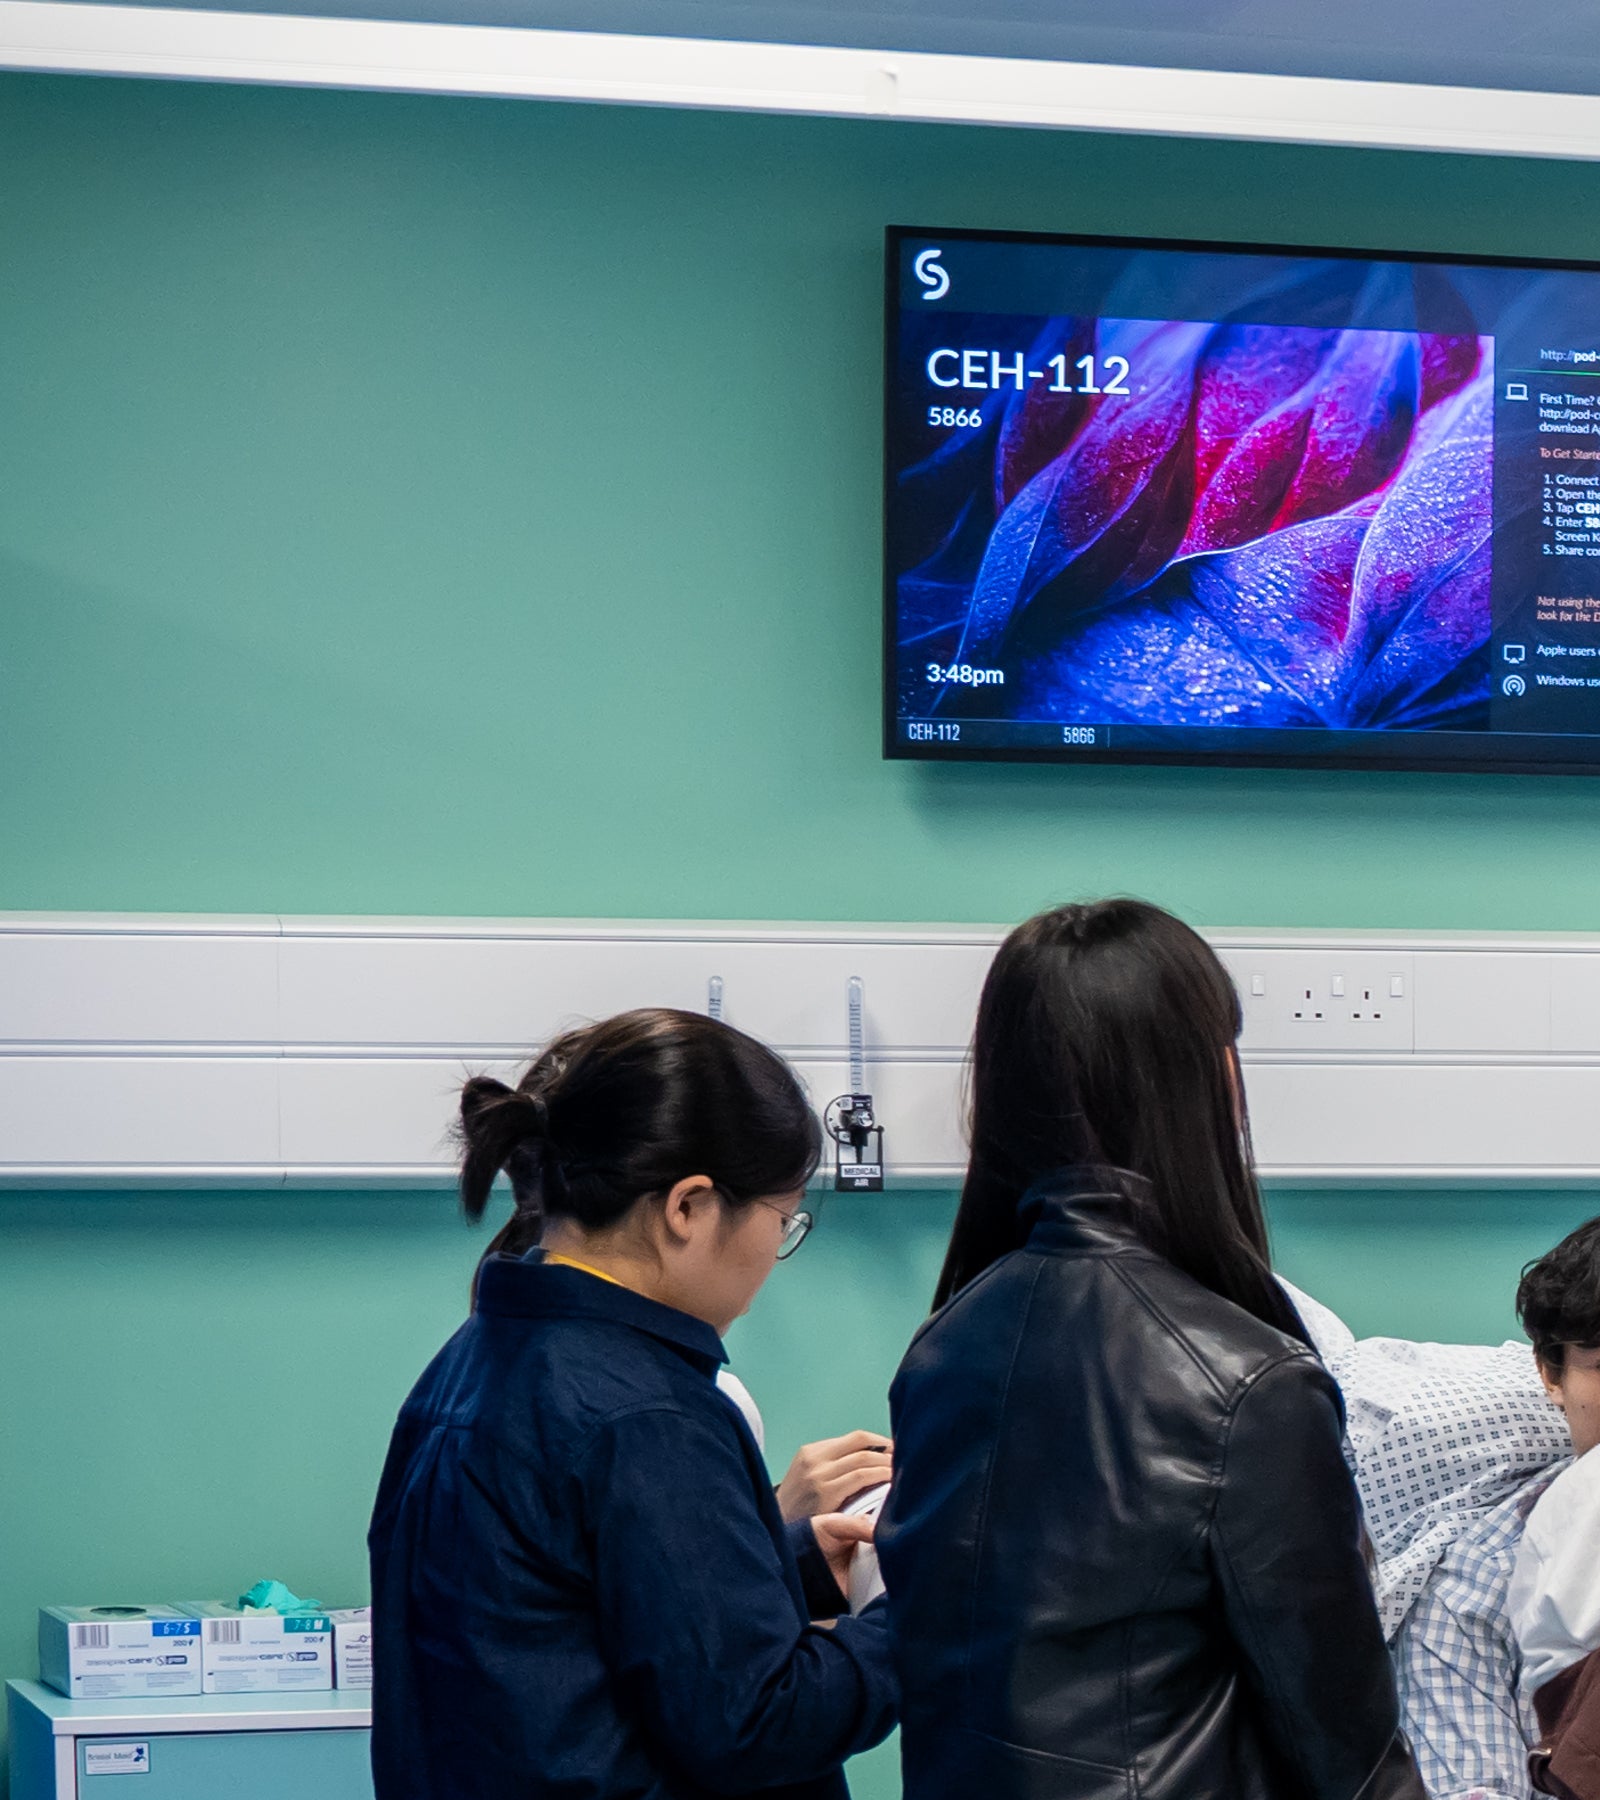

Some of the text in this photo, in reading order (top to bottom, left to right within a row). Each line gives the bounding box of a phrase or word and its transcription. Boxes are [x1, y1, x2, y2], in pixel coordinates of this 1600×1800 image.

[927, 349, 1130, 395] CEH-112
[1540, 393, 1563, 405] First
[1565, 395, 1594, 406] Time?
[928, 406, 982, 428] 5866
[1539, 422, 1589, 435] download
[1540, 448, 1551, 459] To
[1553, 448, 1570, 460] Get
[1544, 475, 1553, 485] 1.
[1556, 474, 1599, 487] Connect
[1543, 489, 1553, 499] 2.
[1556, 490, 1584, 502] Open
[1543, 503, 1553, 513] 3.
[1556, 503, 1574, 516] Tap
[1543, 516, 1553, 527] 4.
[1556, 517, 1583, 528] Enter
[1555, 531, 1590, 543] Screen
[1543, 544, 1553, 555] 5.
[1555, 545, 1584, 556] Share
[1537, 596, 1556, 607] Not
[1558, 598, 1583, 610] using
[1585, 598, 1600, 608] the
[1537, 610, 1557, 621] look
[1559, 611, 1572, 621] for
[1574, 611, 1591, 621] the
[1536, 645, 1567, 657] Apple
[1569, 647, 1596, 657] users
[926, 664, 1004, 687] 3:48pm
[1536, 675, 1584, 687] Windows
[908, 723, 960, 741] CEH-112
[1063, 727, 1095, 744] 5866
[854, 1179, 869, 1187] AIR
